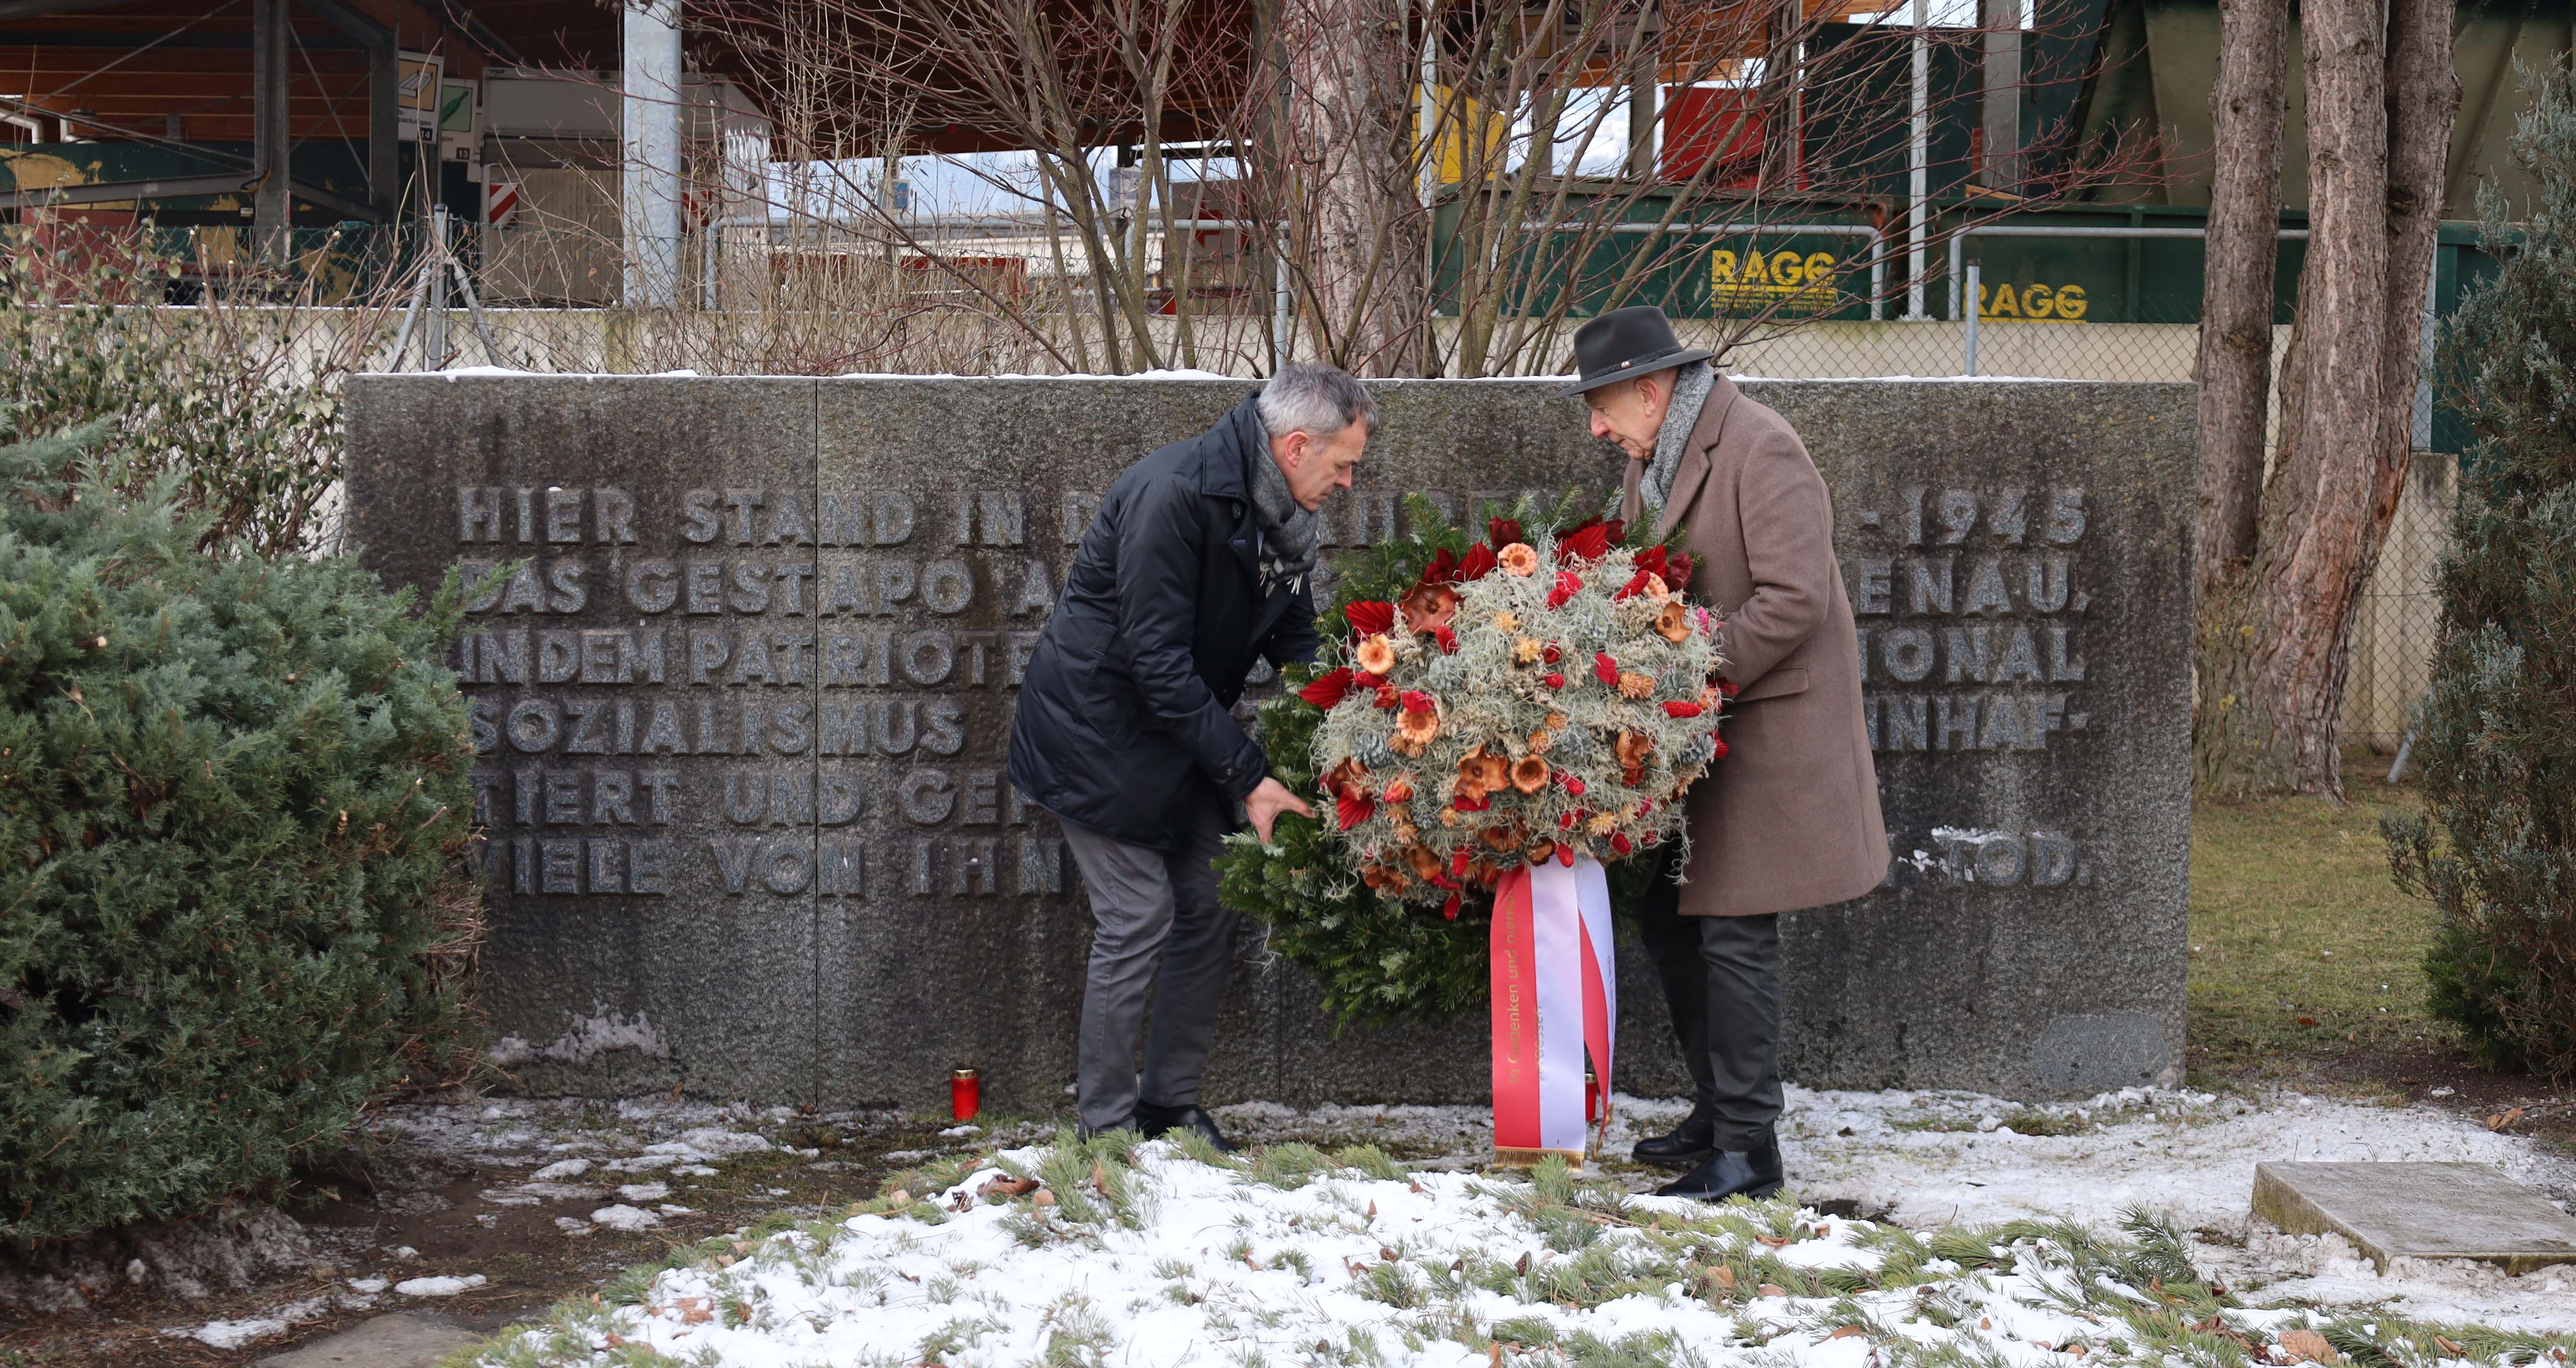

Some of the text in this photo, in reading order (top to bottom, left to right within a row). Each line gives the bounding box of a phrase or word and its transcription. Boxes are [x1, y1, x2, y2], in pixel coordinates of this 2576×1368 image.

[421, 130, 430, 139] 14
[458, 149, 468, 157] 13
[1712, 249, 1836, 286] RAGG
[1963, 282, 2087, 319] RAGG
[458, 487, 637, 544] HIER
[682, 487, 914, 548] STAND
[959, 489, 1023, 547] IN
[461, 558, 587, 615] DAS
[627, 558, 974, 617] GESTAPO
[472, 699, 963, 757] SOZIALISMUS
[468, 772, 679, 826] TIERT
[722, 772, 864, 827] UND
[467, 838, 1063, 897] VIELE VON IHN
[1505, 949, 1518, 979] und
[1507, 984, 1521, 1063] Gedenken
[1508, 1069, 1521, 1083] In
